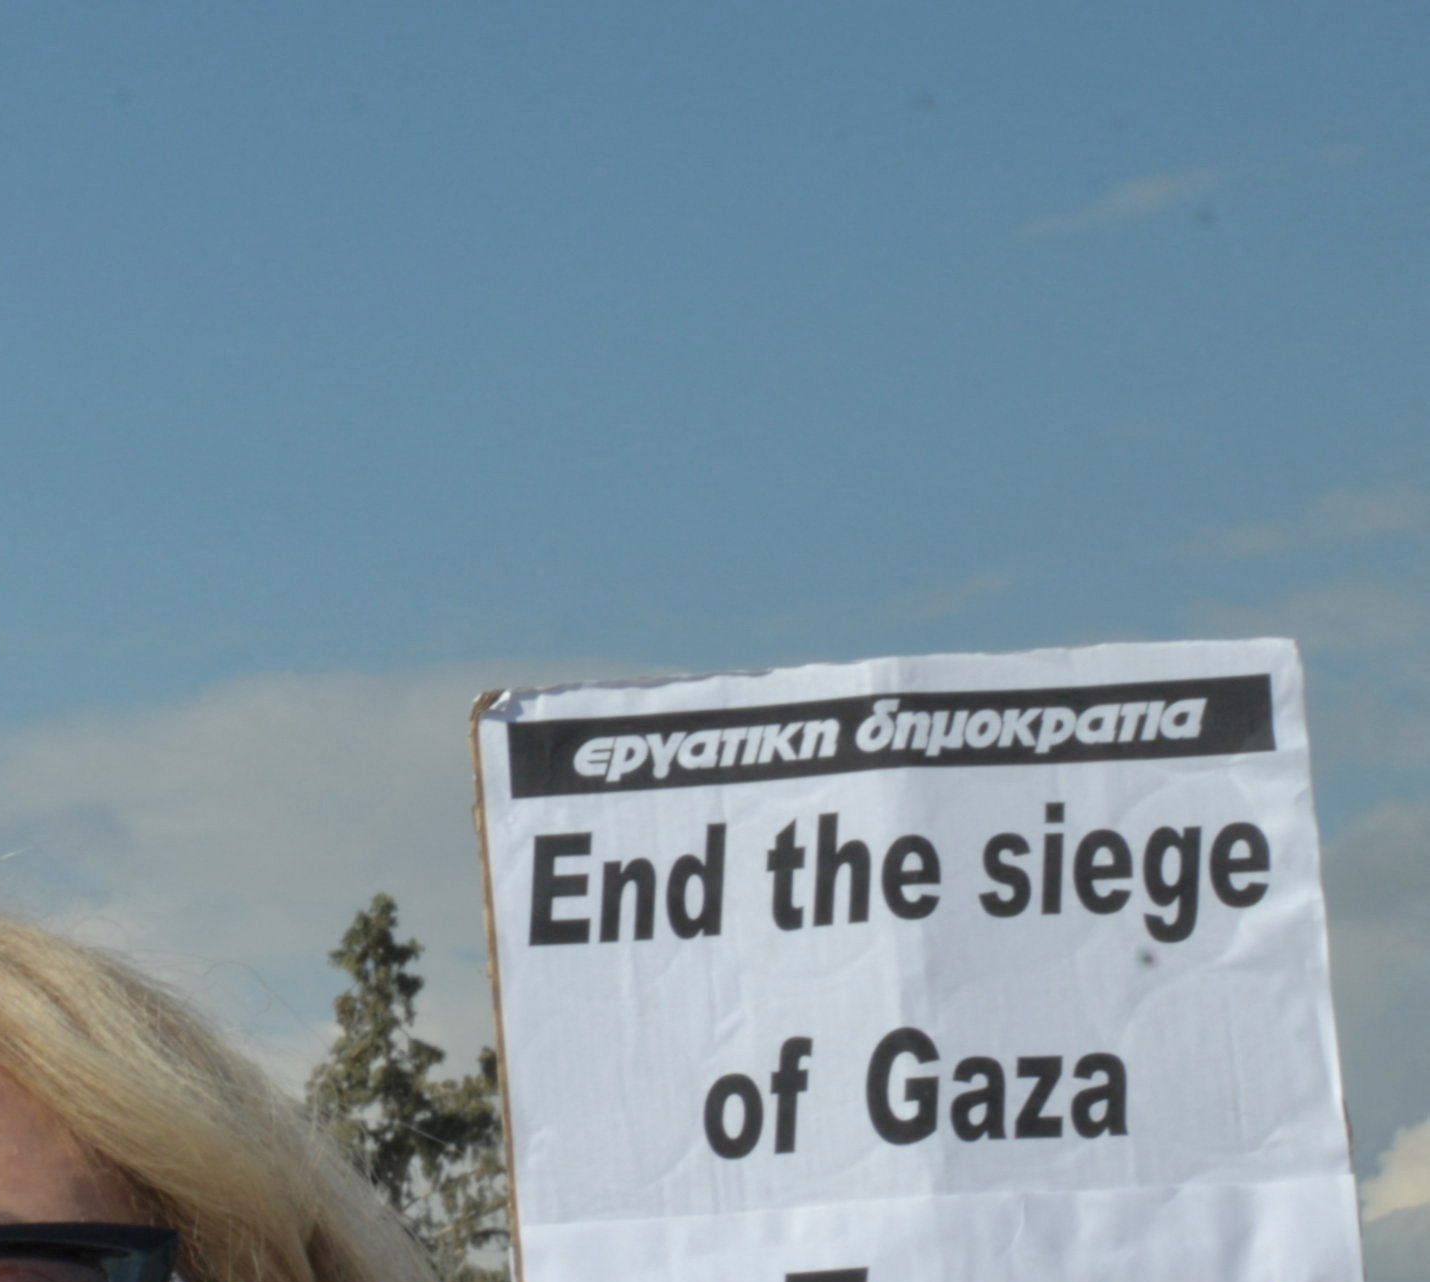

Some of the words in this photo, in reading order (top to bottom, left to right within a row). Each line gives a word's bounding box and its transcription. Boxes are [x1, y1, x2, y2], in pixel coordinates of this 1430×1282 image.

[528, 823, 726, 946] End
[766, 813, 942, 934] the
[980, 803, 1272, 942] siege
[704, 1037, 813, 1159] of
[866, 1027, 1128, 1146] Gaza
